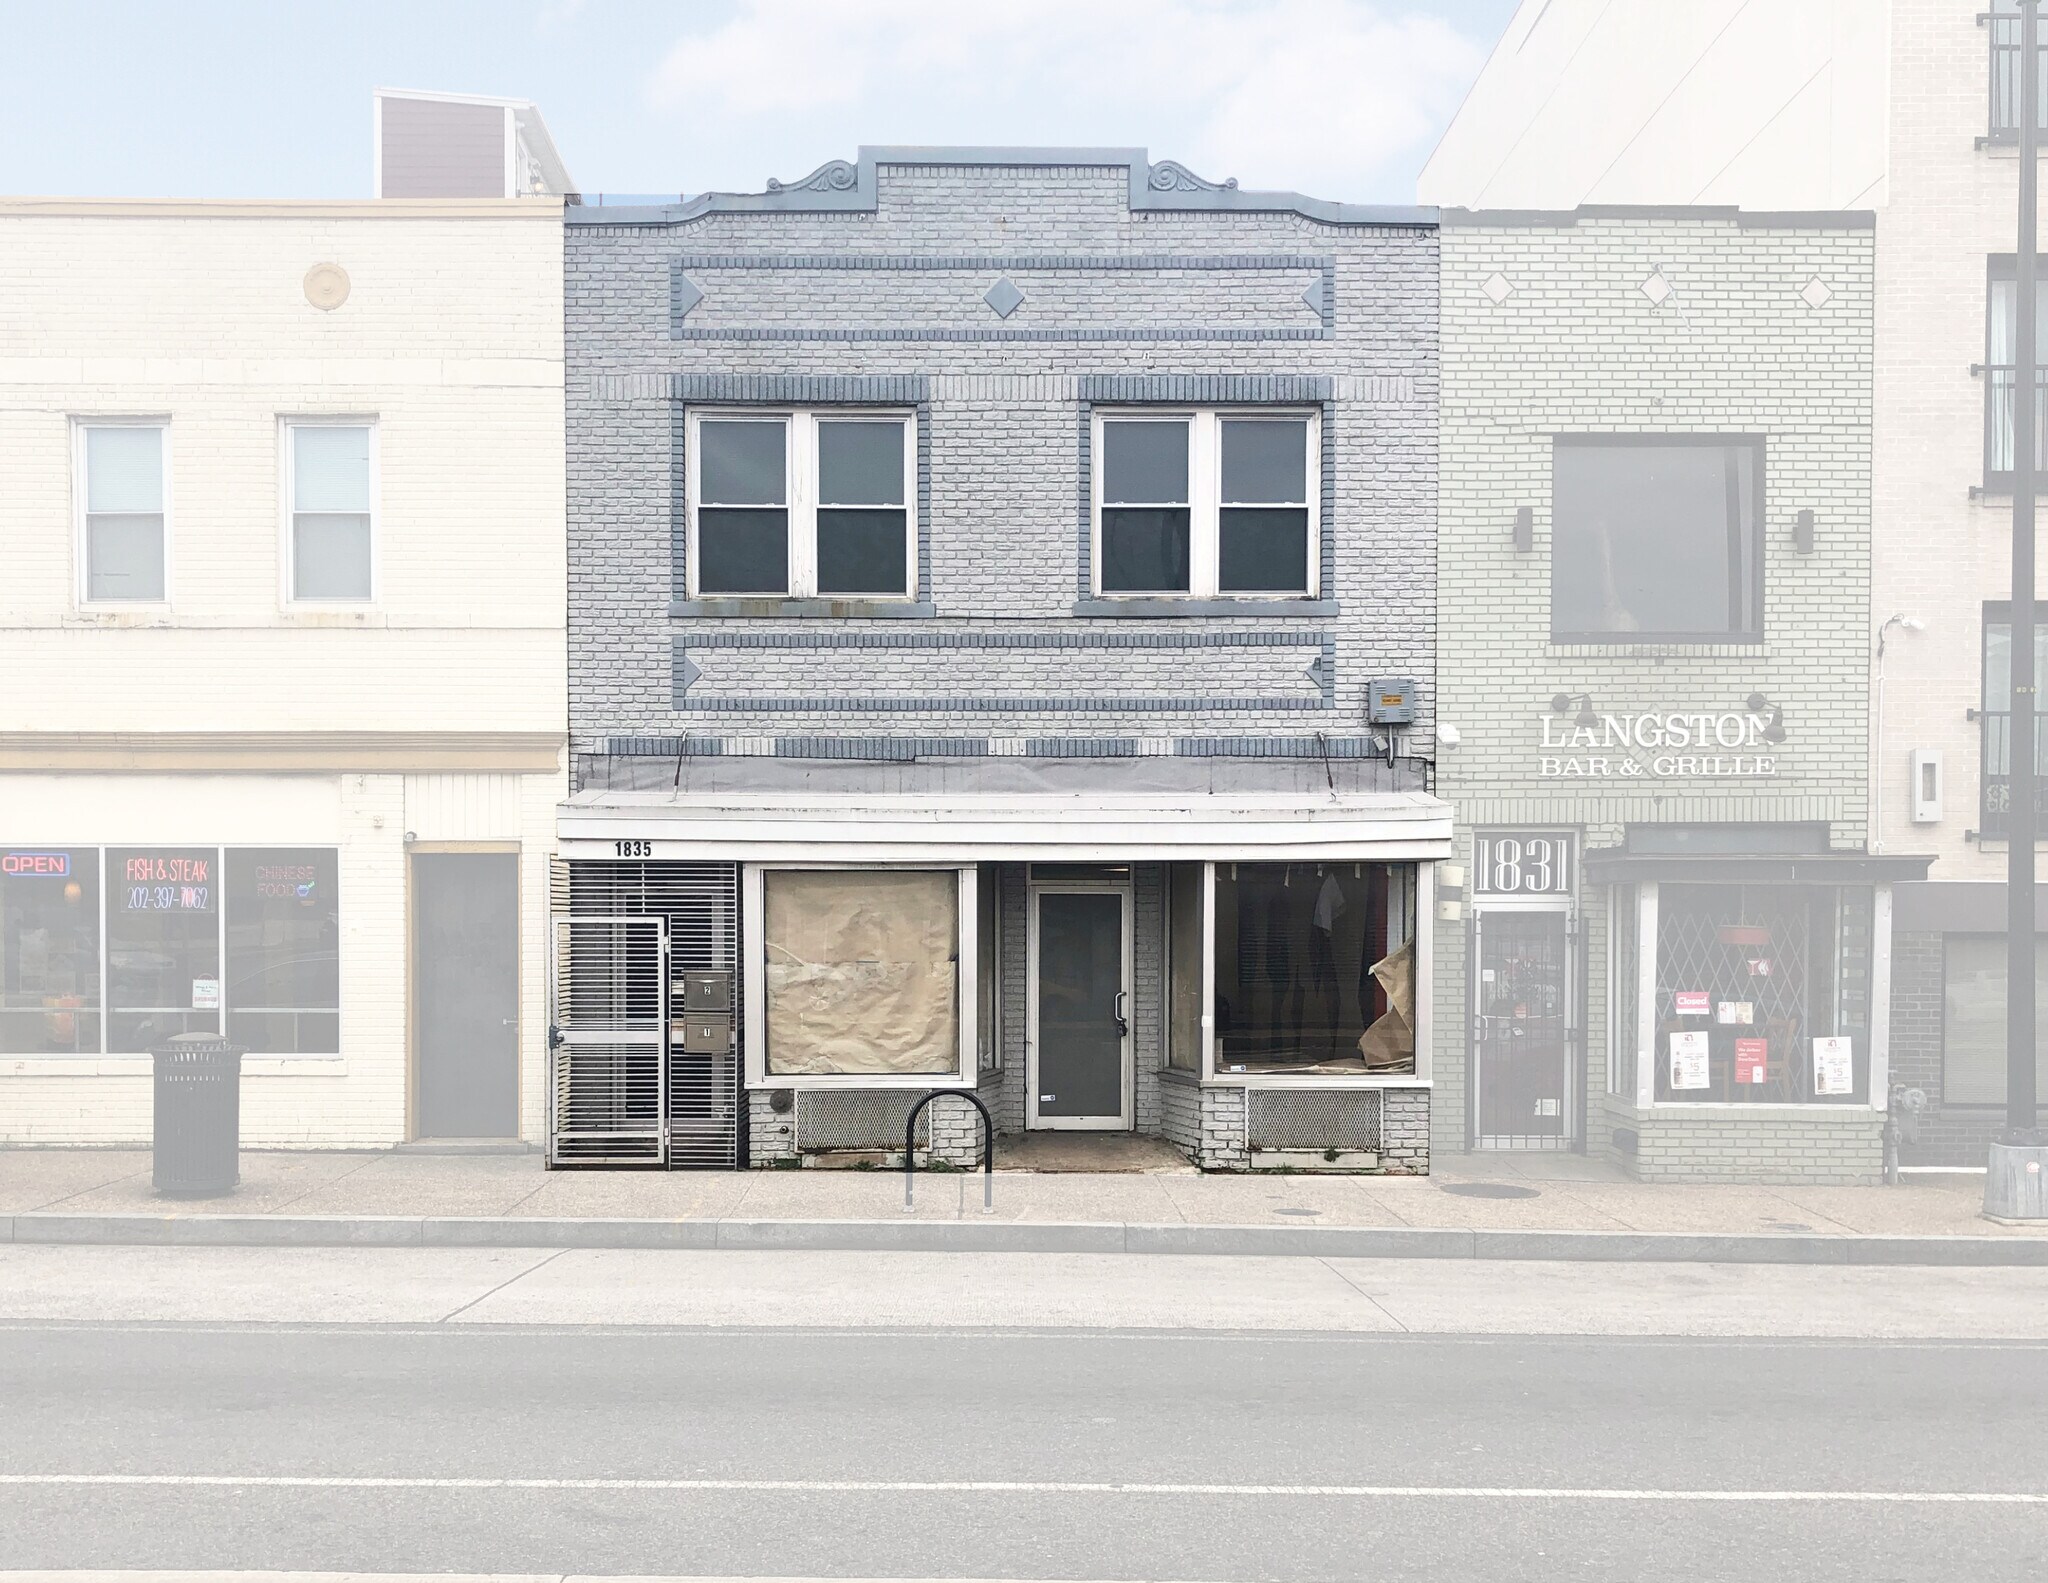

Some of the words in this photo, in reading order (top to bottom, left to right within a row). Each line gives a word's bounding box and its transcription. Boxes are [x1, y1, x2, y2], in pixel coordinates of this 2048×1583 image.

[1539, 713, 1775, 748] LANGSTON
[1539, 757, 1611, 777] BAR
[1619, 757, 1643, 777] &
[1653, 756, 1776, 777] GRILLE
[615, 841, 651, 857] 1835
[2, 856, 65, 873] OPEN
[126, 858, 154, 881] FISH
[156, 858, 167, 881] &
[169, 858, 208, 882] STEAK
[255, 865, 315, 880] CHINESE
[1476, 838, 1569, 892] 1831
[257, 883, 296, 897] FOOD
[1677, 996, 1707, 1005] Closed
